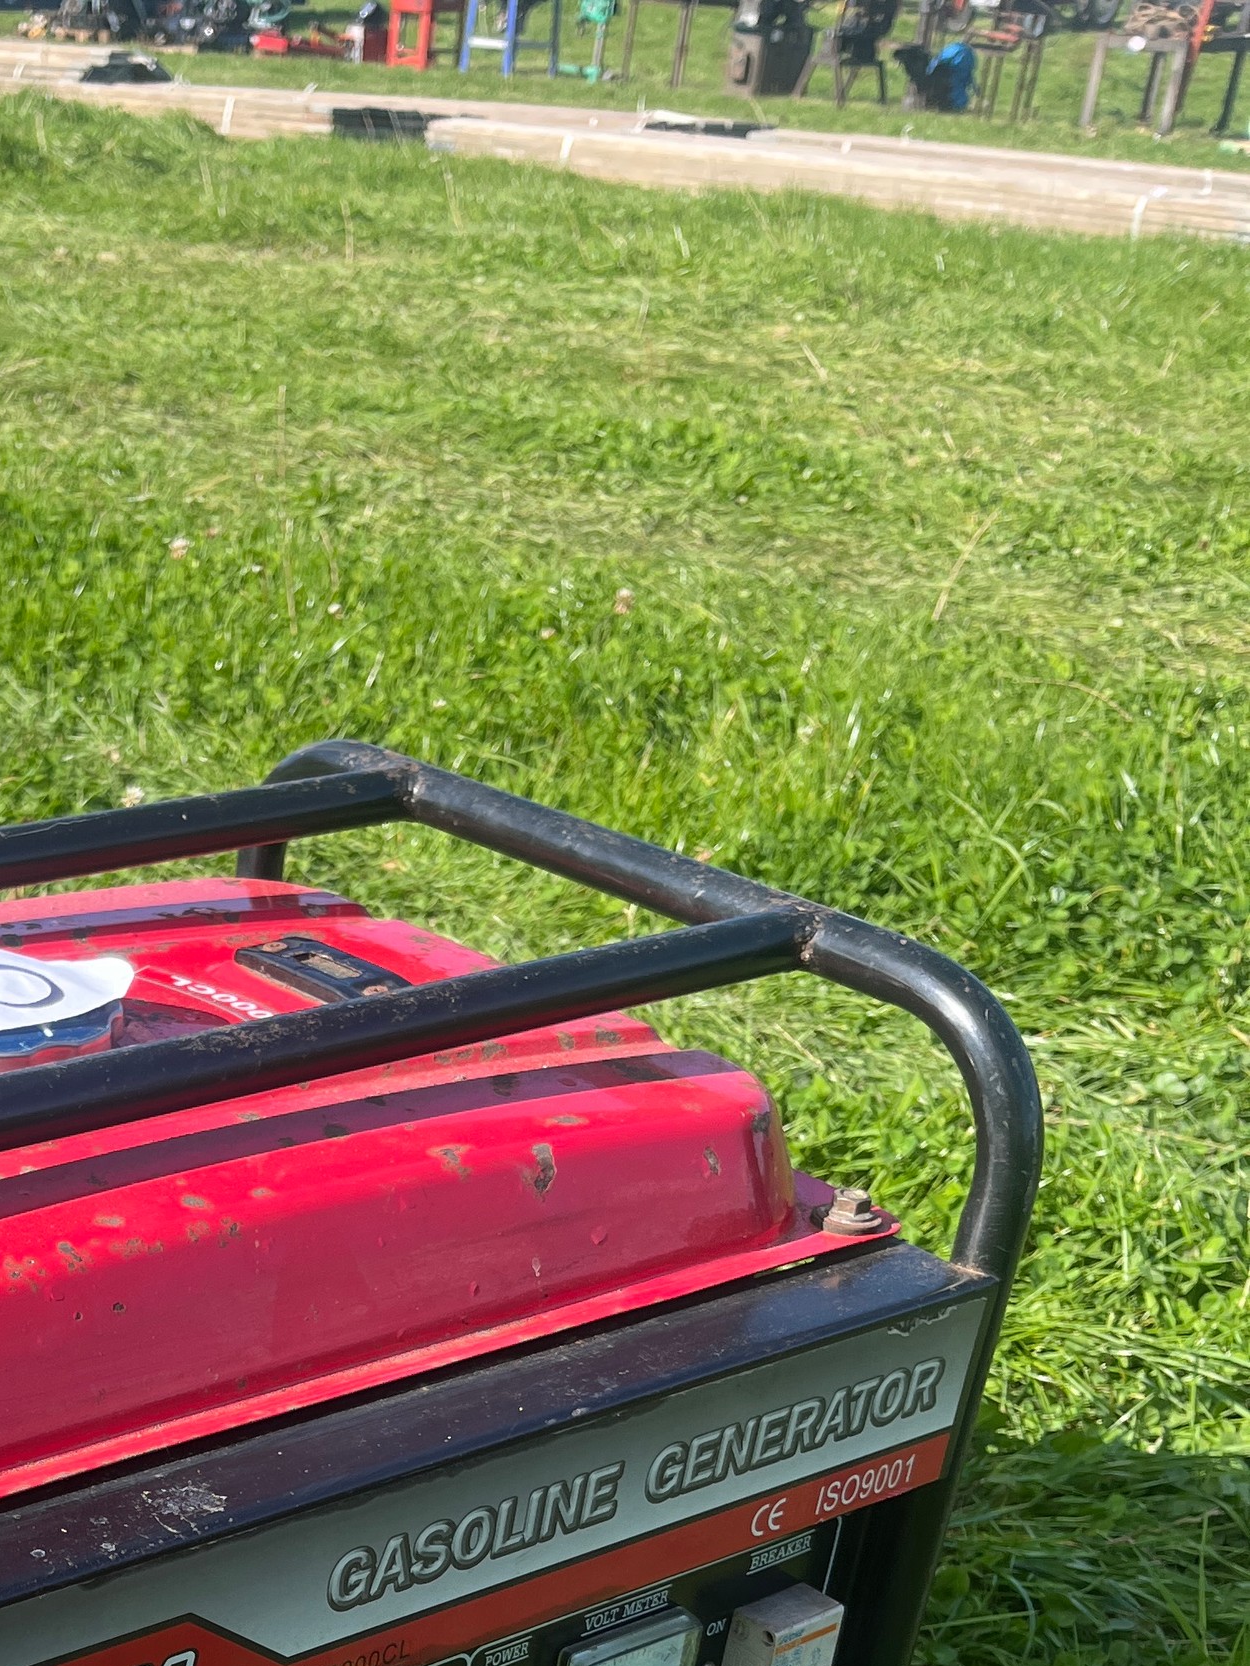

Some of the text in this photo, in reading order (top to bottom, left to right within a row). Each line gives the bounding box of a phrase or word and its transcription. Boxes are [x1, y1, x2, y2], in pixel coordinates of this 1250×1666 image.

[170, 974, 274, 1019] 000CL
[327, 1357, 945, 1612] GASOLINE GENERATOR
[751, 1453, 916, 1537] CE ISO9001
[750, 1535, 812, 1570] BREAKER
[585, 1590, 669, 1631] VOLT METER
[706, 1618, 727, 1636] ON
